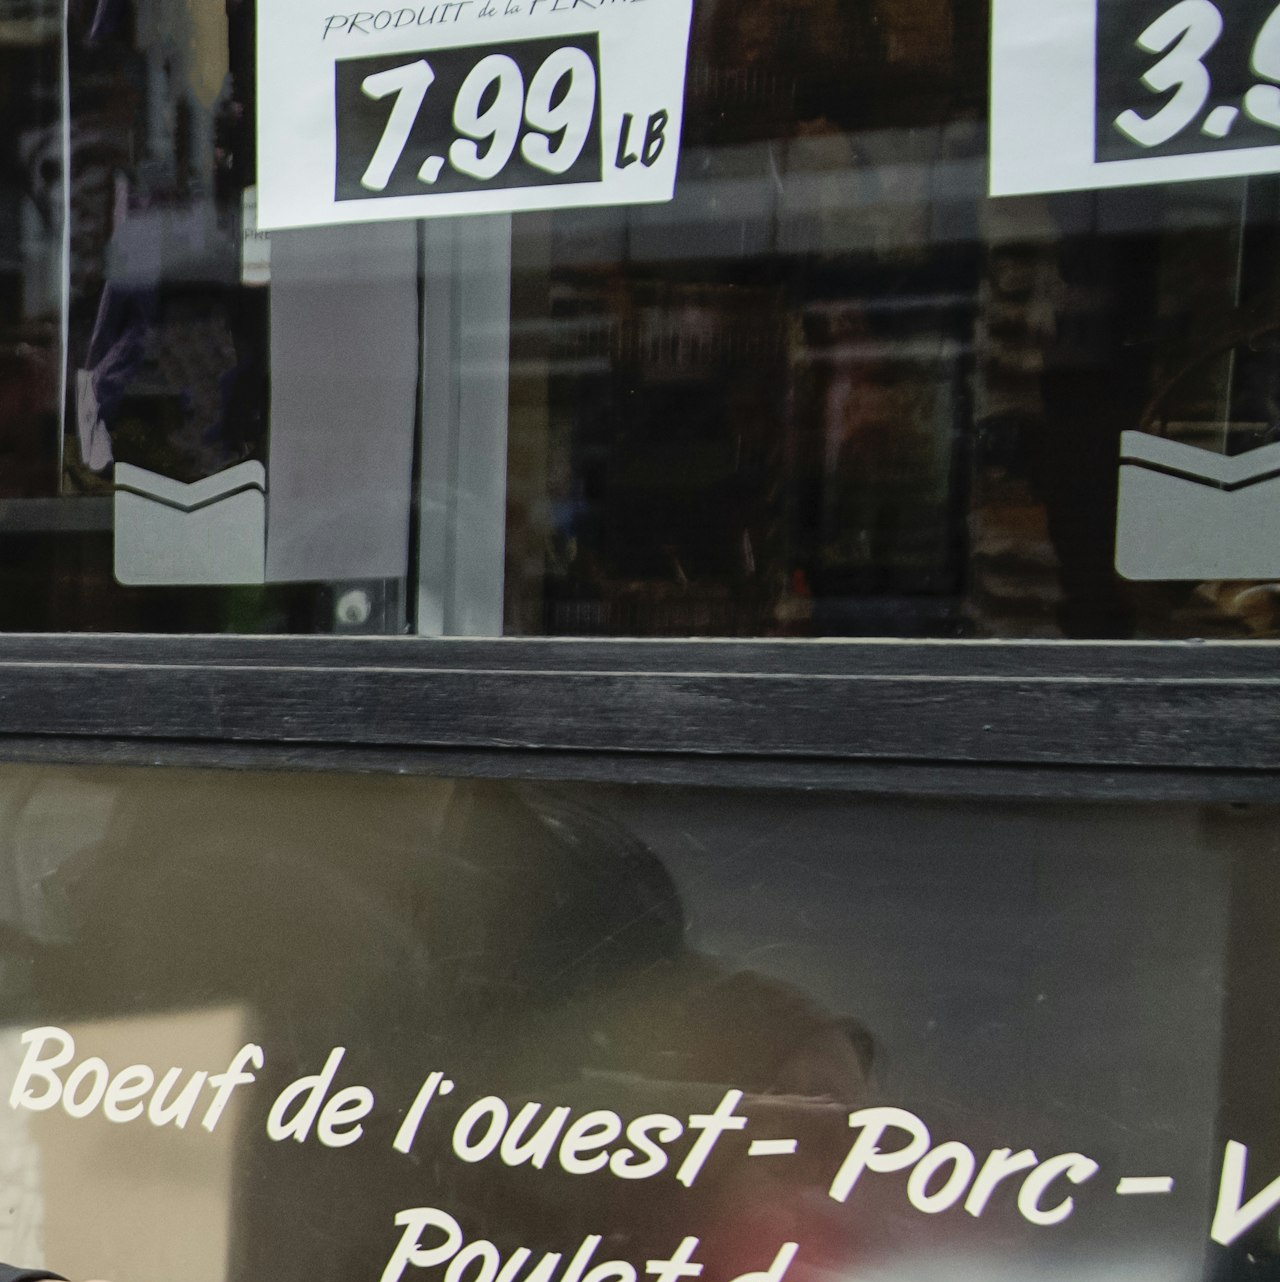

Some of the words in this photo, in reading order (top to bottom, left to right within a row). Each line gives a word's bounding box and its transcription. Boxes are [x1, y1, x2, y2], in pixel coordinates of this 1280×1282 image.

[321, 0, 474, 40] PRODUIT
[477, 0, 497, 18] de
[503, 0, 521, 16] la
[360, 46, 597, 192] 7.99
[614, 107, 669, 169] LB
[9, 1026, 263, 1132] Boeuf
[267, 1047, 374, 1147] de
[831, 1107, 1098, 1226] Porc
